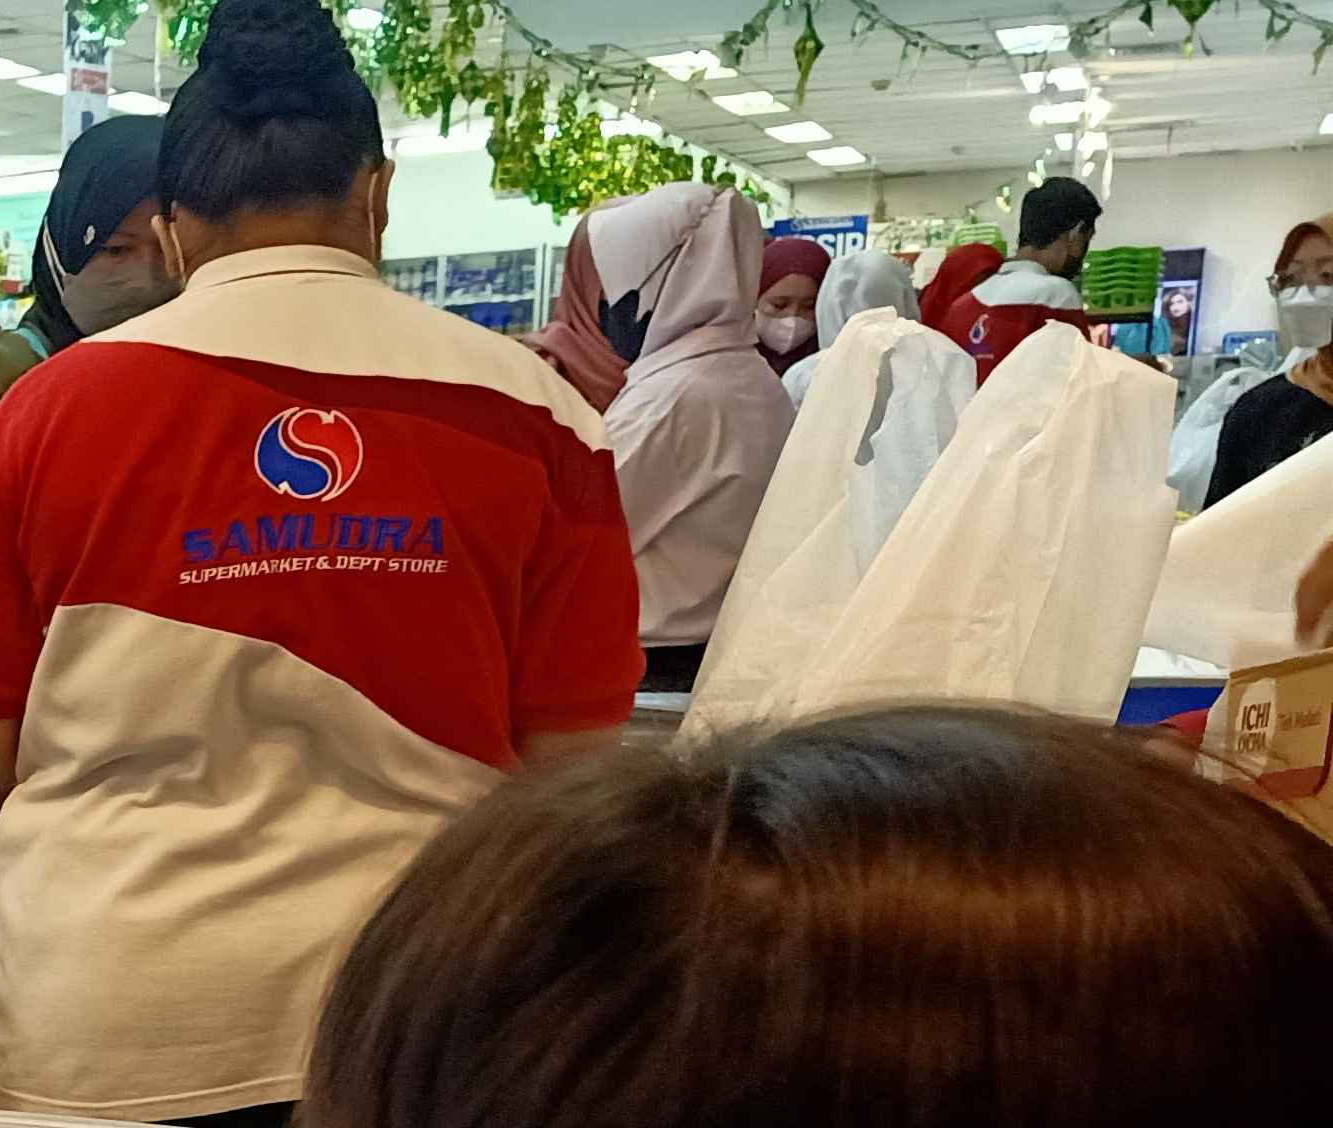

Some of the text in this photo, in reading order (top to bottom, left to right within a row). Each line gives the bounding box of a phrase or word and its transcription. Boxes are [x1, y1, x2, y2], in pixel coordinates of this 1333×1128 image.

[183, 512, 446, 563] SAMUDRA
[179, 556, 448, 585] SUPERMARKET & DEPT STORE
[1241, 701, 1271, 731] ICHI
